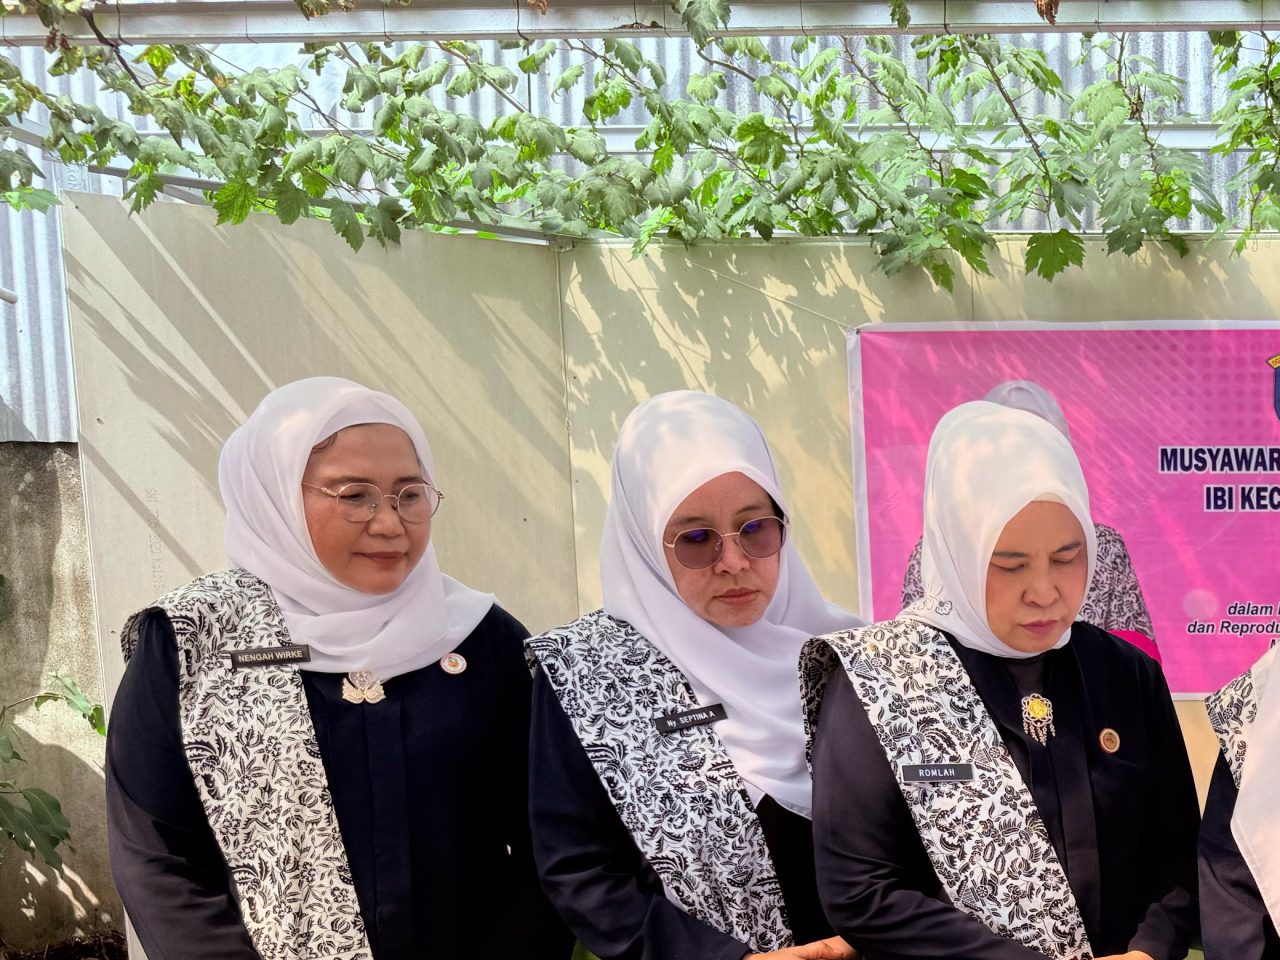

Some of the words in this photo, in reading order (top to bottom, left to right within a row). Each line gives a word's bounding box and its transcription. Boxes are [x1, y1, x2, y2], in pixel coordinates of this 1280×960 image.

[1205, 486, 1234, 510] IBI
[1228, 602, 1273, 615] dalam
[1187, 621, 1215, 633] dan
[238, 652, 274, 663] NENGAH
[275, 650, 304, 660] WIRKE
[679, 712, 709, 725] SEPTINA
[919, 768, 955, 777] ROMLAH
